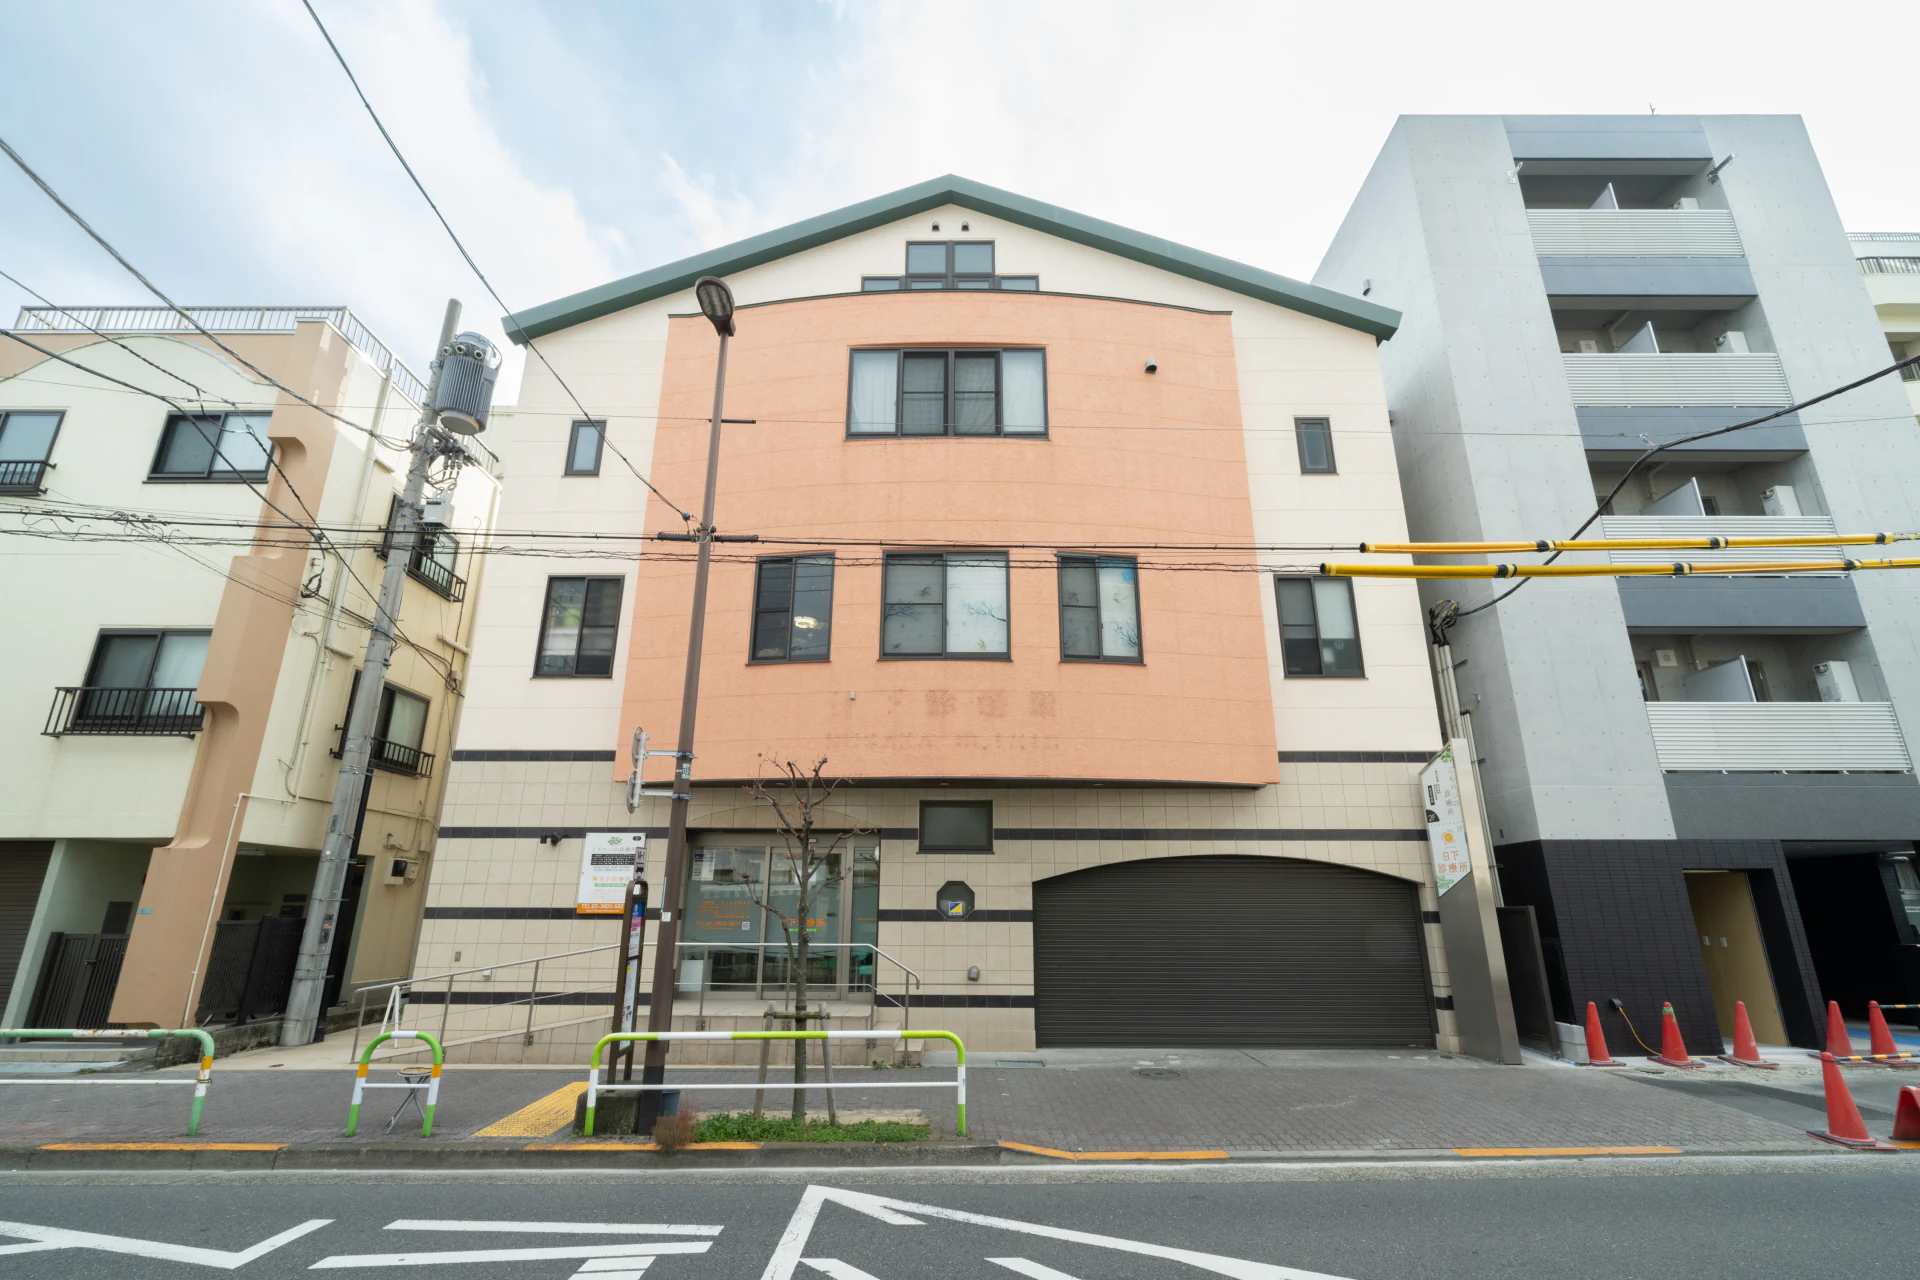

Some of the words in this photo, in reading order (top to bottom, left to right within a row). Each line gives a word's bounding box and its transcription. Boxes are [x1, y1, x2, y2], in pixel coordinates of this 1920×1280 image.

[1428, 813, 1437, 822] 2F
[1442, 850, 1459, 861] 日下
[1437, 861, 1468, 874] 診療所
